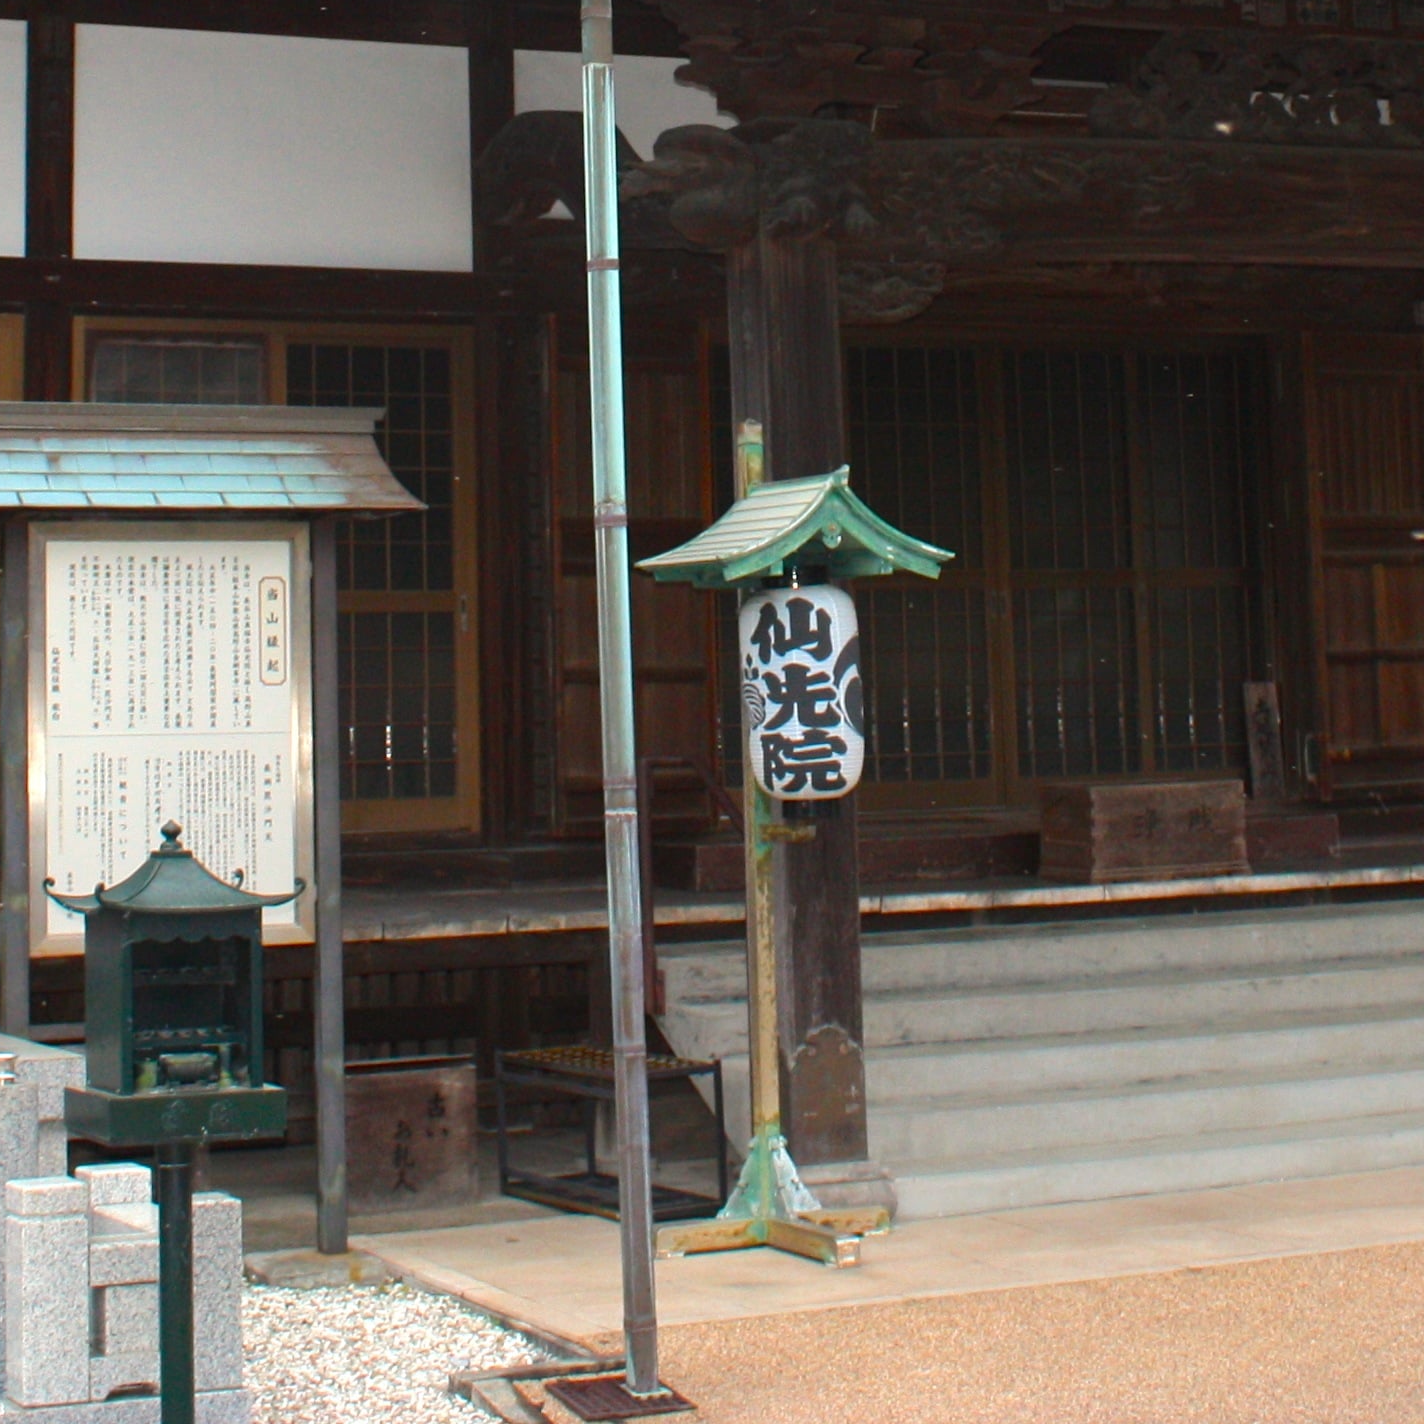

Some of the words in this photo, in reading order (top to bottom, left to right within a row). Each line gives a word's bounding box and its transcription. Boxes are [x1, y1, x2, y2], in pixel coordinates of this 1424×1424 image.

[266, 588, 279, 673] 当山縁起
[750, 597, 847, 792] 仙光院
